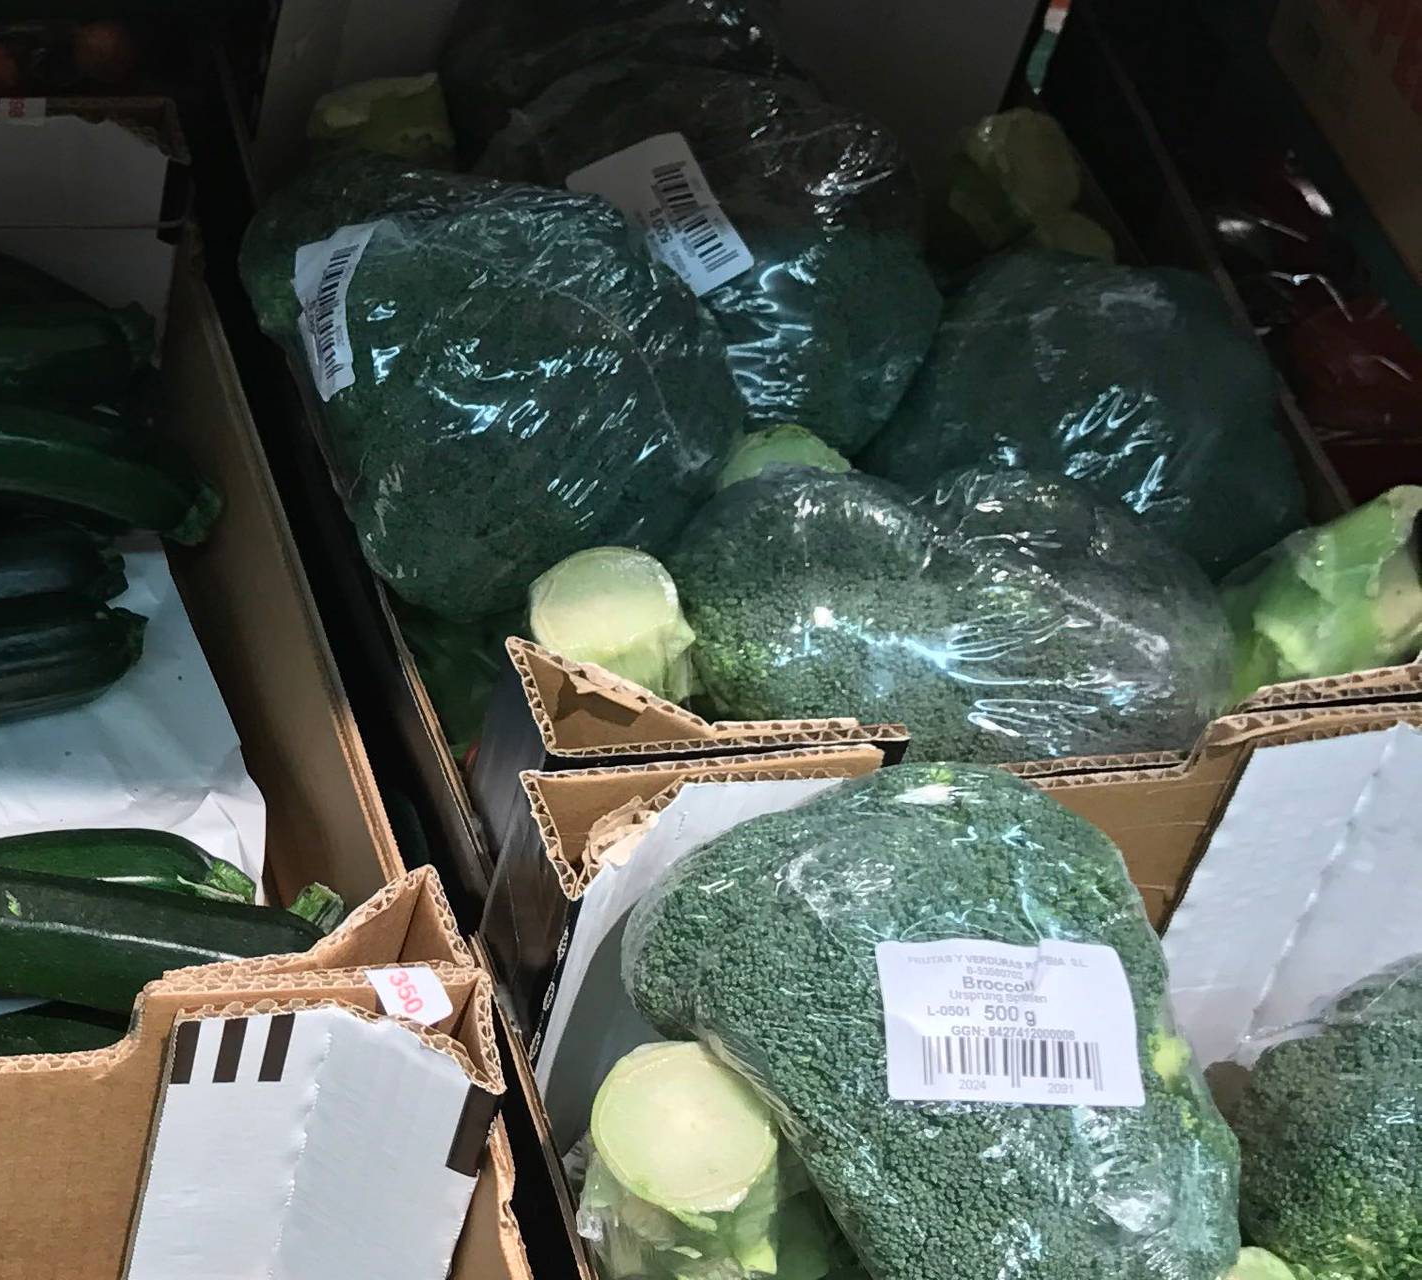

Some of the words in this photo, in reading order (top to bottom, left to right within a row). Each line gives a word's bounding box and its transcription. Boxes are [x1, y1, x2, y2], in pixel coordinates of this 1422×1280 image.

[390, 972, 423, 1013] 350
[948, 990, 1003, 1005] Ursprung
[927, 1005, 970, 1018] L-0501
[983, 1004, 1019, 1022] 500
[1025, 1008, 1037, 1027] g
[951, 1025, 985, 1038] GGN:
[958, 1078, 987, 1091] 2024
